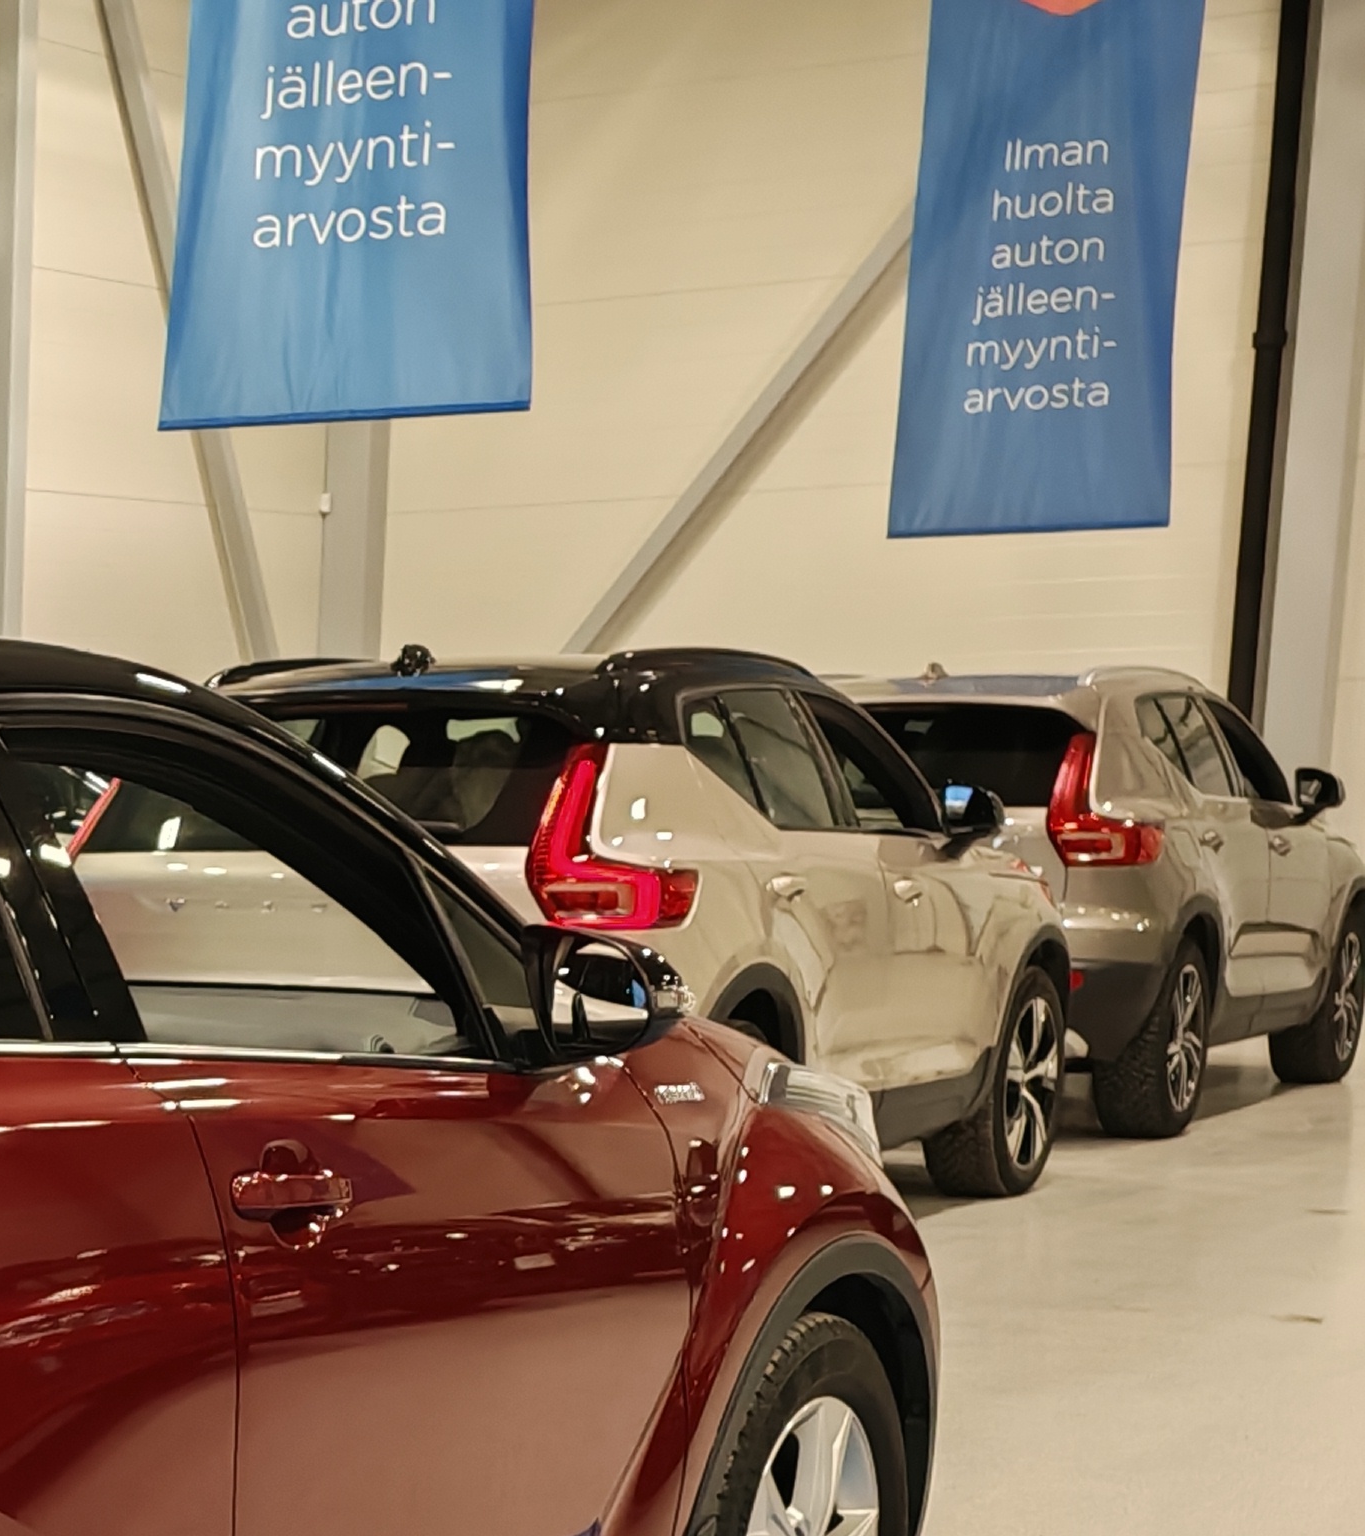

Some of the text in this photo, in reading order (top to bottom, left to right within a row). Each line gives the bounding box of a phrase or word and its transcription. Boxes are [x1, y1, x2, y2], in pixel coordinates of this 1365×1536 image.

[286, 0, 436, 39] auton
[260, 59, 452, 119] jälleen-
[254, 120, 456, 186] myynti-
[1004, 138, 1109, 172] Ilman
[253, 195, 447, 249] arvosta
[991, 182, 1115, 222] huolta
[990, 235, 1105, 269] auton
[972, 283, 1116, 325] jälleen-
[966, 326, 1117, 370] myynti-
[963, 377, 1110, 415] arvosta
